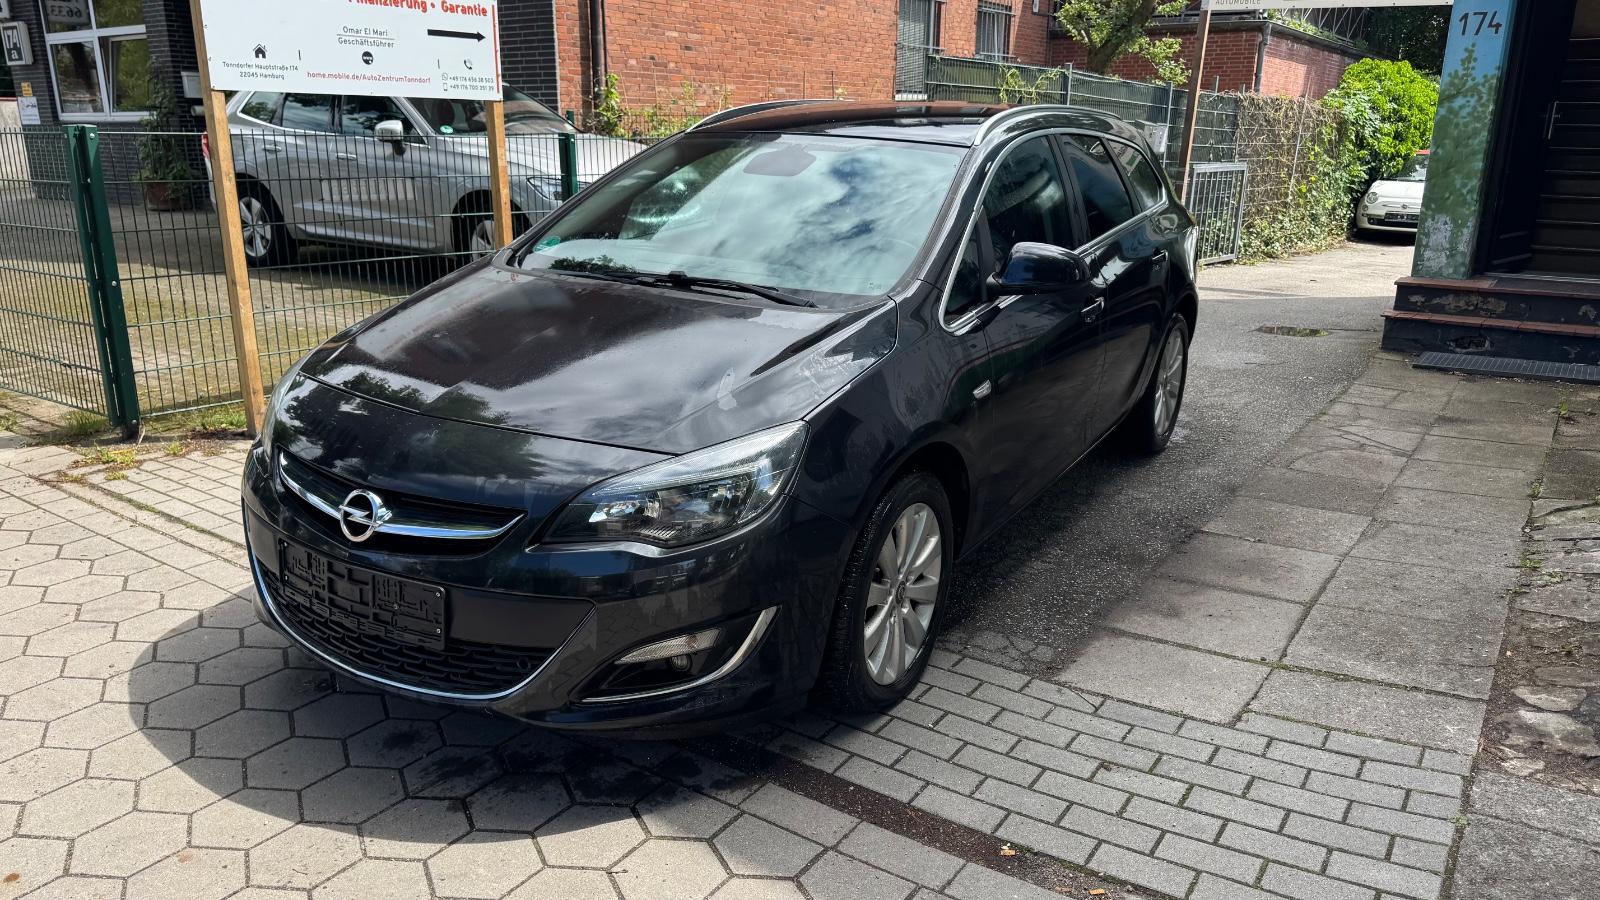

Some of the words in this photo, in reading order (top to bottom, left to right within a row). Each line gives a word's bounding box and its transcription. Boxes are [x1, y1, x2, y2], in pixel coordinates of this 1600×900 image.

[347, 0, 428, 13] anzierung
[441, 2, 488, 16] Garantie
[1459, 10, 1502, 35] 174
[342, 25, 362, 35] Omar
[363, 27, 371, 36] El
[372, 28, 388, 38] Mari
[4, 29, 20, 48] 174
[337, 37, 395, 49] Geschäftsführer
[11, 50, 19, 60] a
[222, 61, 253, 70] Tonndorfer
[254, 63, 289, 71] Hauptstraße
[259, 72, 285, 80] Hamburg
[307, 71, 431, 84] home.mobile.de/AutoZentrumTonndorf
